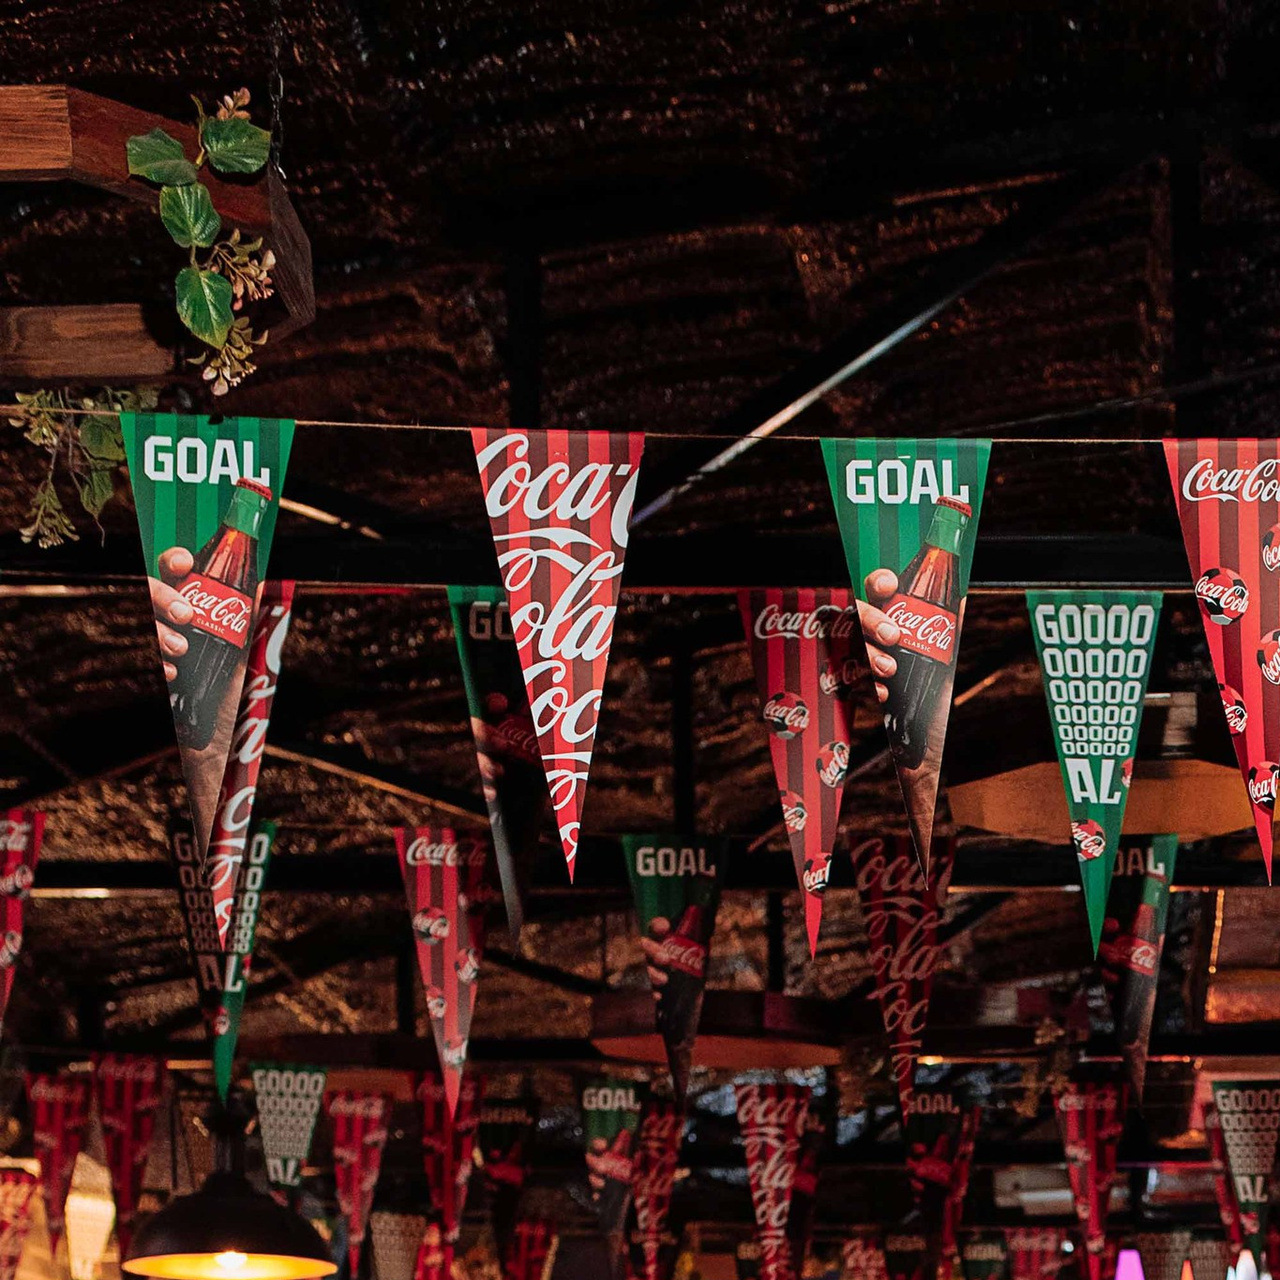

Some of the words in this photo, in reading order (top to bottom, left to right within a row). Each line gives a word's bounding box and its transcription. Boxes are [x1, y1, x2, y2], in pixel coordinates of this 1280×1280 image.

[144, 436, 270, 487] GOAL
[845, 459, 970, 504] GOAL
[196, 619, 226, 634] CLASSIC
[754, 603, 855, 640] Coca-Cola
[1035, 604, 1154, 645] GOOOO
[903, 638, 931, 653] CLASSIC
[1043, 648, 1148, 678] OOOOO
[1050, 679, 1142, 703] OOOOO
[1054, 704, 1137, 724] OOOOO
[1058, 725, 1133, 742] OOOOO
[1062, 741, 1130, 756] OOOOO
[1065, 758, 1121, 804] AL
[636, 846, 716, 877] GOAL
[583, 1087, 641, 1111] GOAL
